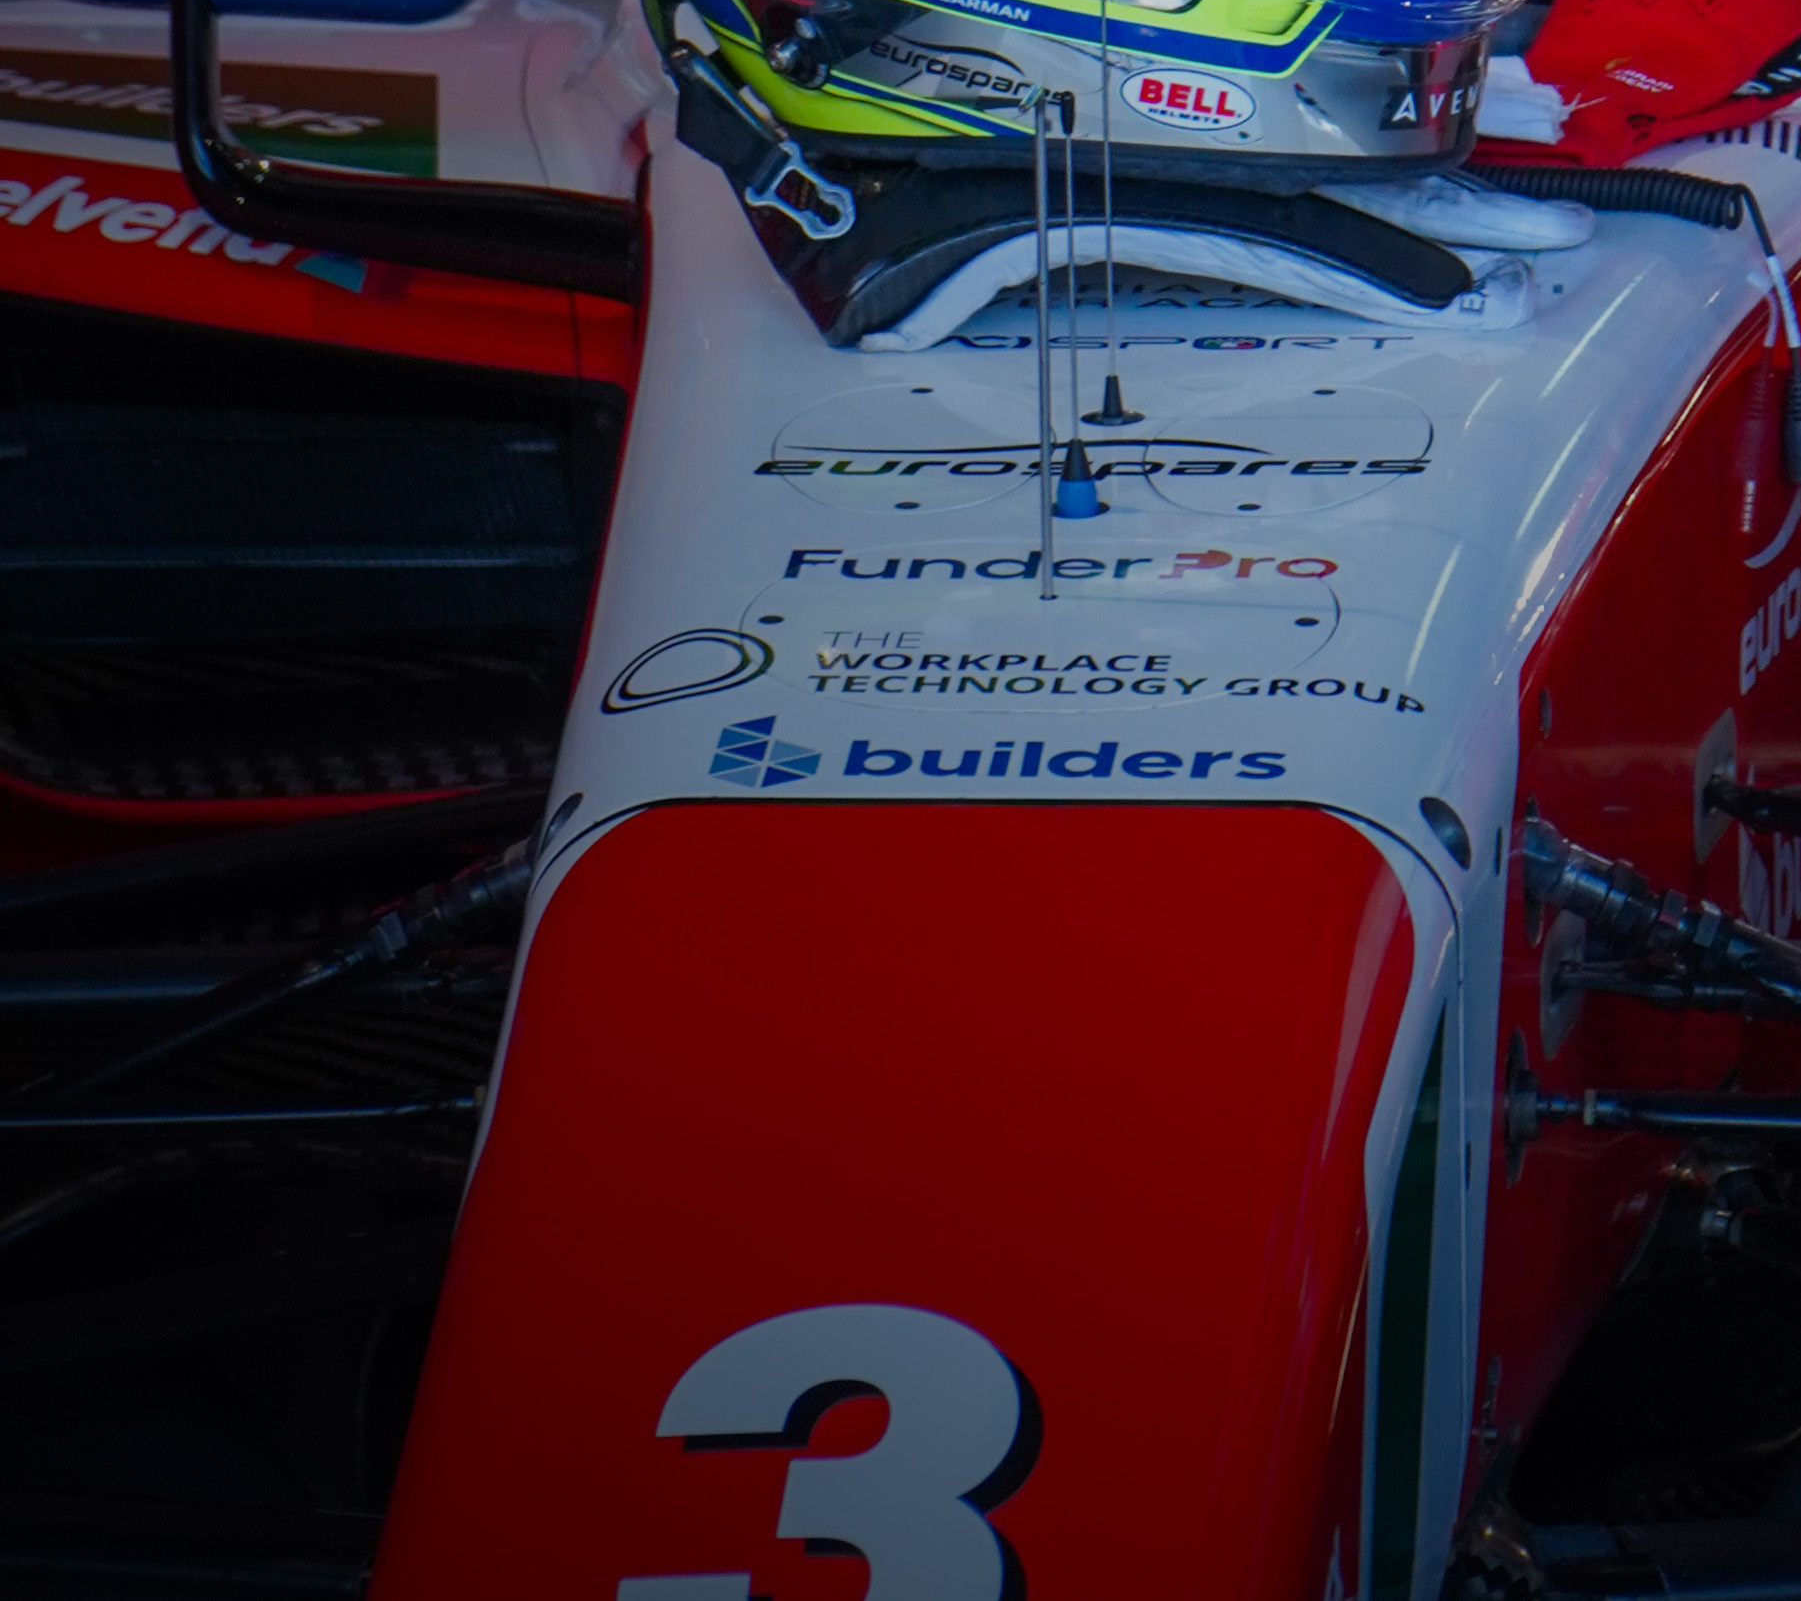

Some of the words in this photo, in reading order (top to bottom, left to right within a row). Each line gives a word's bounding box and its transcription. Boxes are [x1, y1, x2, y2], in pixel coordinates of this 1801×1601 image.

[1139, 77, 1236, 118] BELL
[1148, 107, 1220, 125] HELMETS
[823, 630, 923, 649] THE
[815, 653, 1172, 672] WORKPLACE
[808, 674, 1207, 696] TECHNOLOGY
[1226, 677, 1425, 713] GROUP
[843, 740, 1287, 780] builders
[614, 1301, 1044, 1601] 3
